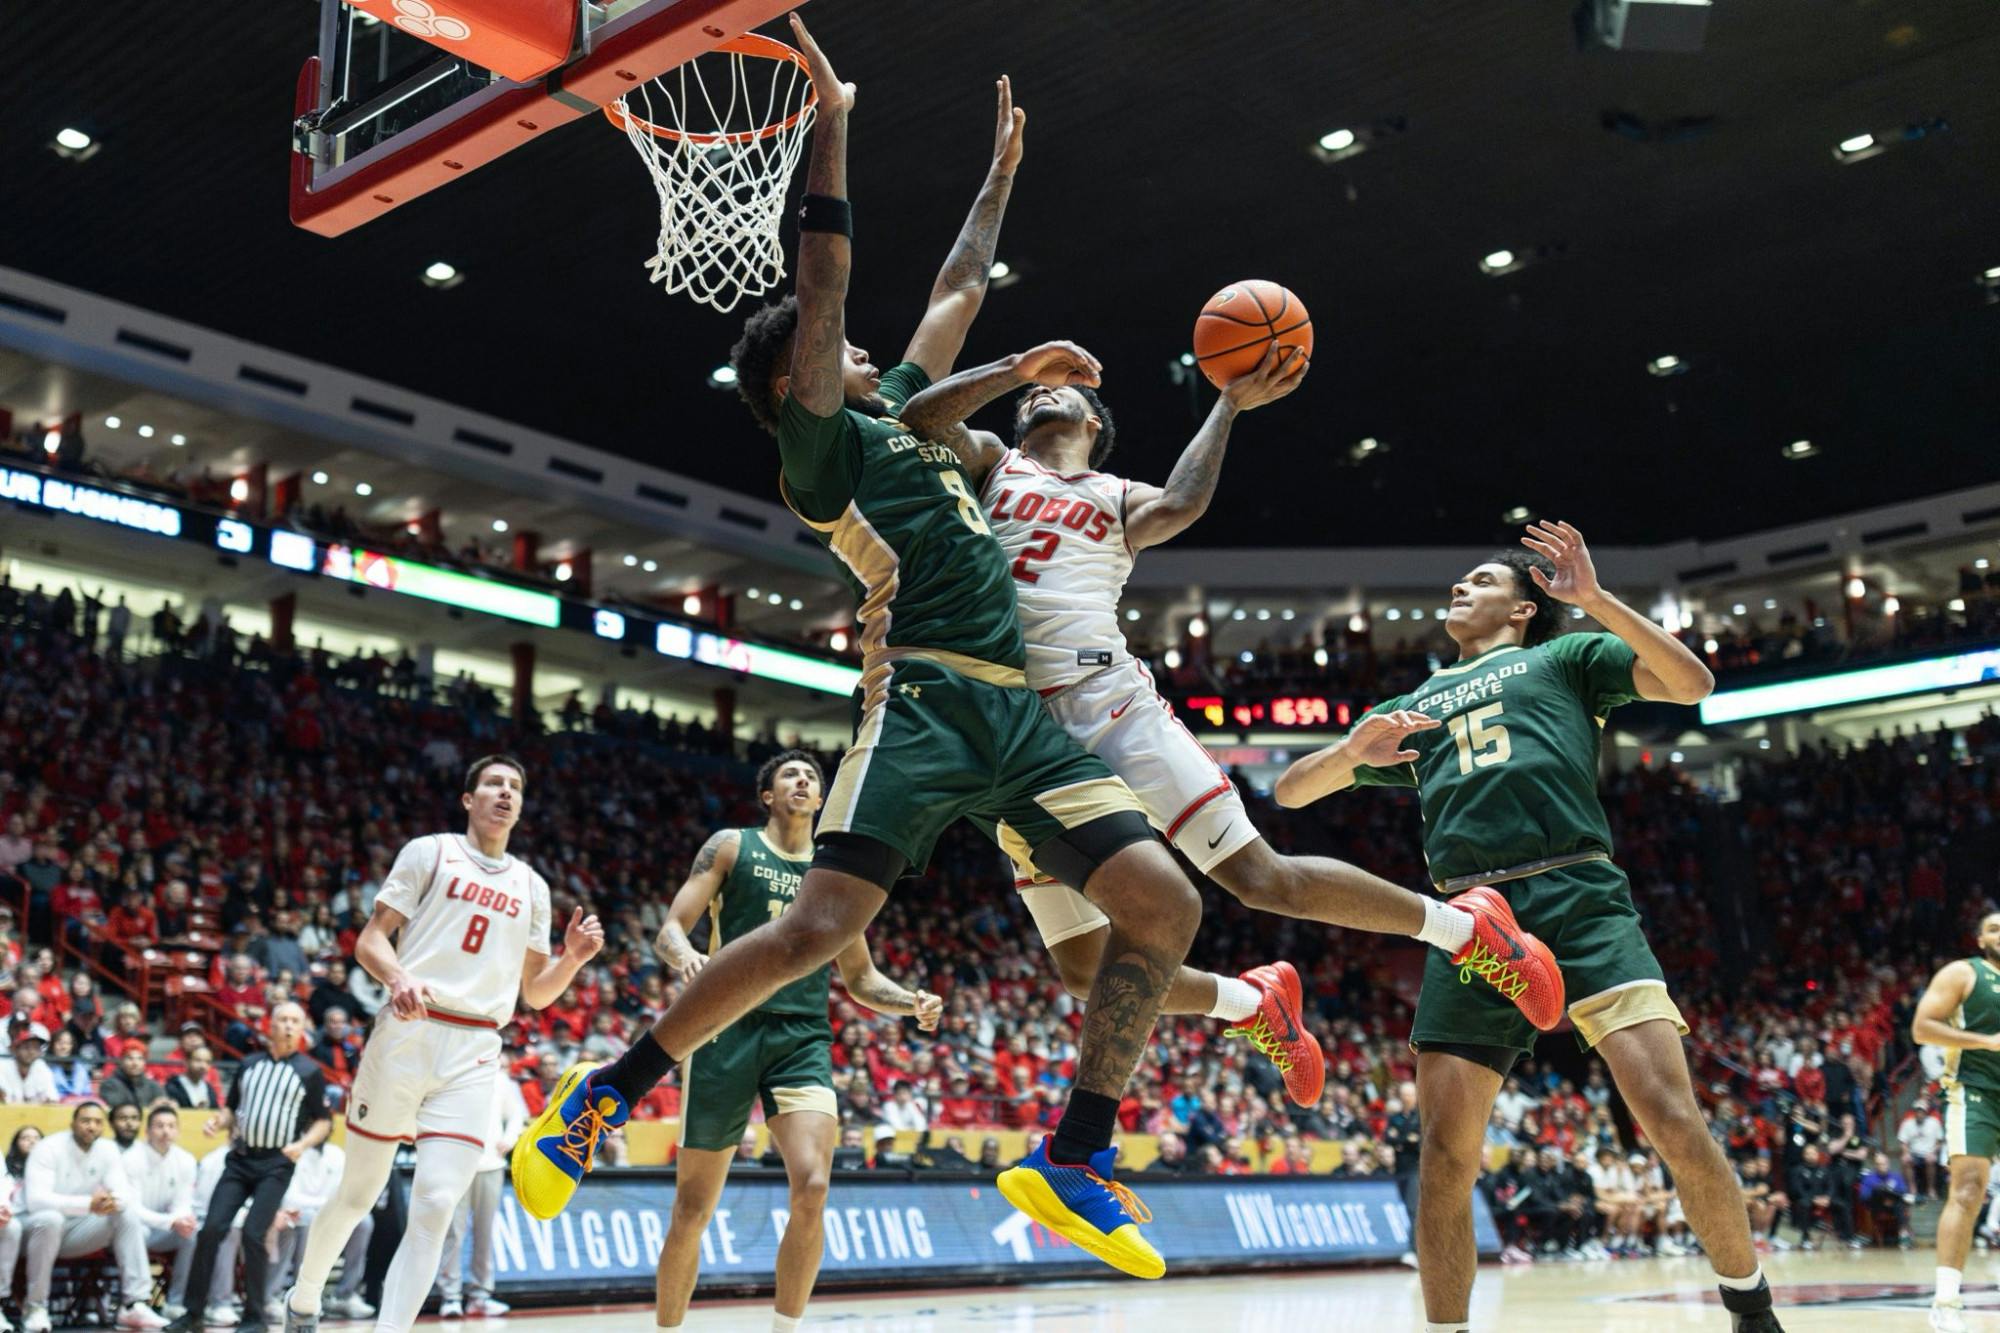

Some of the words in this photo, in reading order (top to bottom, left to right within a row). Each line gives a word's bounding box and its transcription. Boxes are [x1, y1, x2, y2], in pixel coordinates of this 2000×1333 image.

[939, 469, 992, 536] 8
[990, 488, 1116, 542] LOBOS
[1012, 529, 1061, 584] 2
[1417, 661, 1528, 713] COLORADO
[1441, 680, 1504, 714] STATE
[1447, 701, 1512, 776] 15
[446, 877, 523, 919] LOBOS
[753, 865, 802, 888] COLOR
[769, 880, 801, 898] STA
[461, 914, 490, 954] 8
[1225, 1191, 1378, 1249] INVIGORATE
